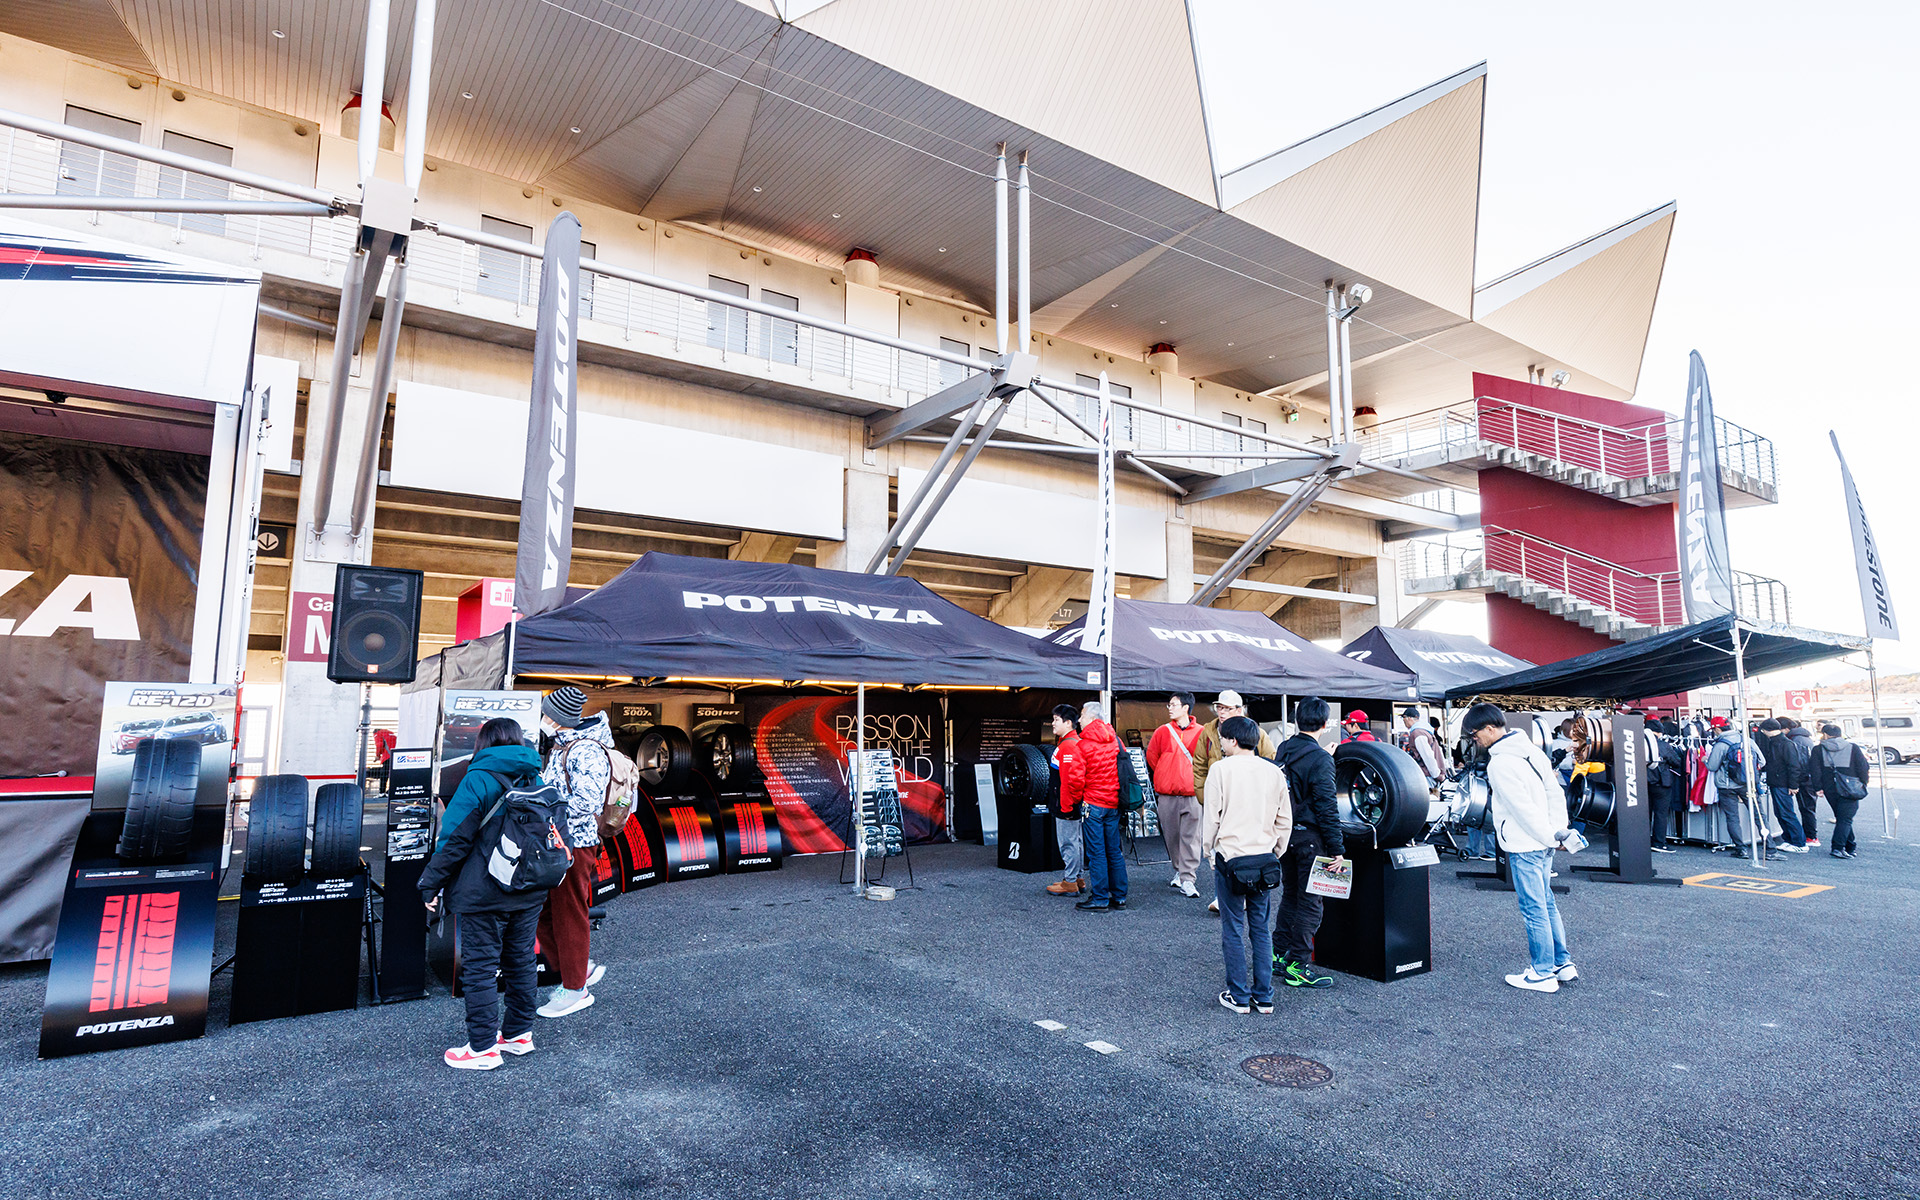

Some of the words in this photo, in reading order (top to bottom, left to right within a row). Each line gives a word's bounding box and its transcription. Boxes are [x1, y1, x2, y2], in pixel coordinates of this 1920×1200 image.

[541, 257, 570, 591] POTENZA
[682, 591, 944, 626] POTENZA
[1149, 627, 1302, 652] POTENZA
[1413, 650, 1515, 668] POTENZA
[455, 699, 533, 711] RE-71RS
[901, 739, 932, 756] THE
[1622, 729, 1638, 808] POTENZA
[678, 863, 710, 873] POTENZA
[738, 857, 772, 866] POTENZA
[76, 1015, 175, 1037] POTENZA
